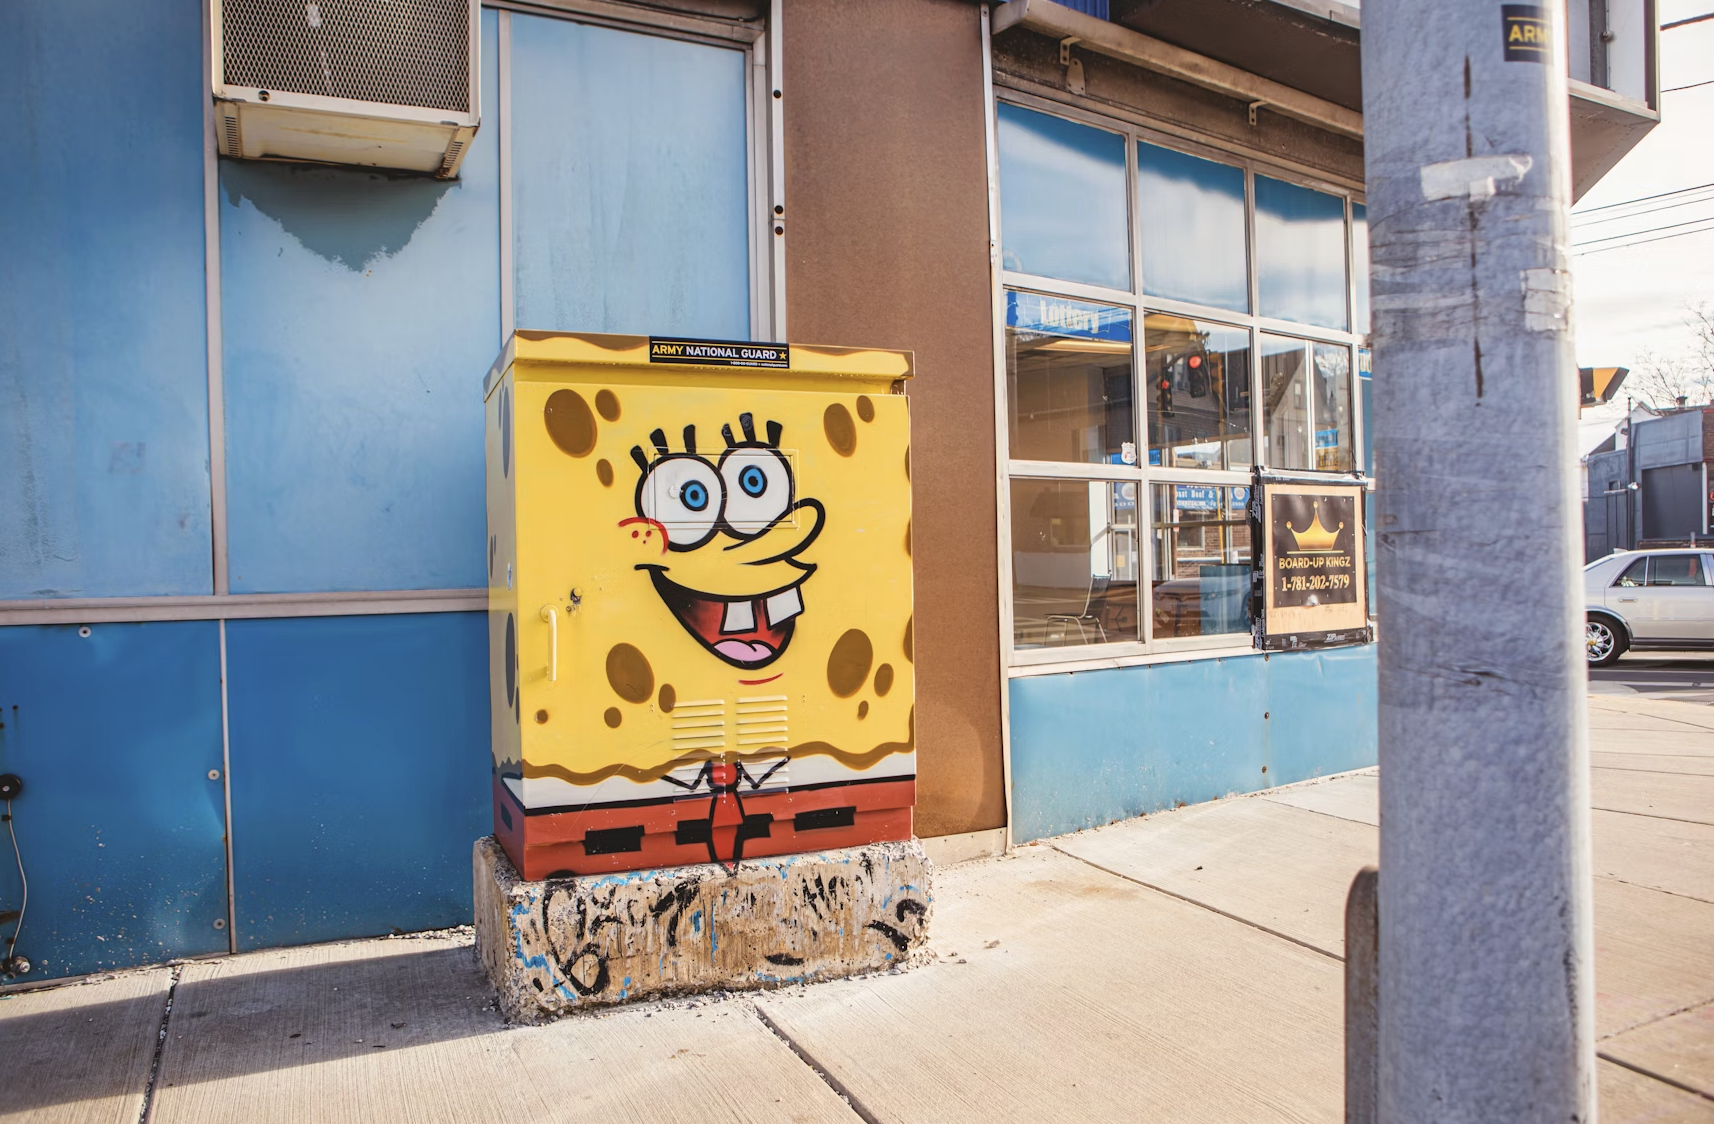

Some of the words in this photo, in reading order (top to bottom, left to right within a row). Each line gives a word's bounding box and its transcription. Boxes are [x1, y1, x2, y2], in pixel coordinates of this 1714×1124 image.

[652, 344, 684, 355] ARMY
[686, 346, 739, 358] NATIONAL
[741, 349, 777, 360] GUARD
[1279, 556, 1325, 570] BOARD-UP
[1326, 556, 1351, 568] KINGZ
[1281, 573, 1350, 592] 1-781-202-7579
